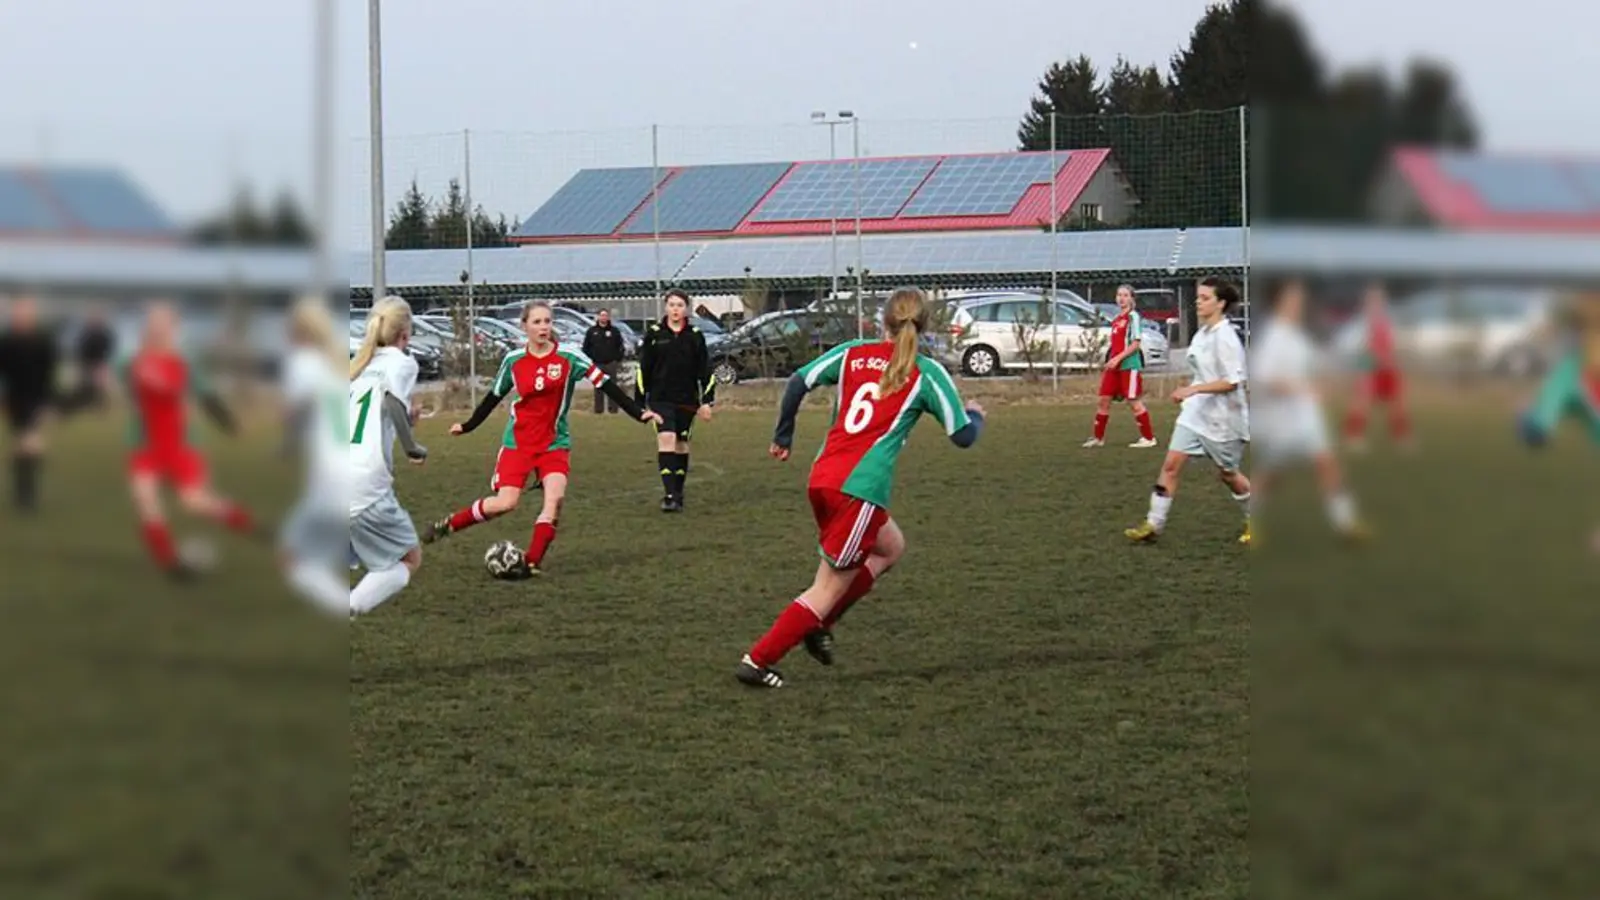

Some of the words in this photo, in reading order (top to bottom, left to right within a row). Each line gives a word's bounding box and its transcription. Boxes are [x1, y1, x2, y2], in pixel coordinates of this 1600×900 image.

[851, 358, 865, 372] FC
[535, 376, 545, 391] 8
[844, 381, 881, 434] 6
